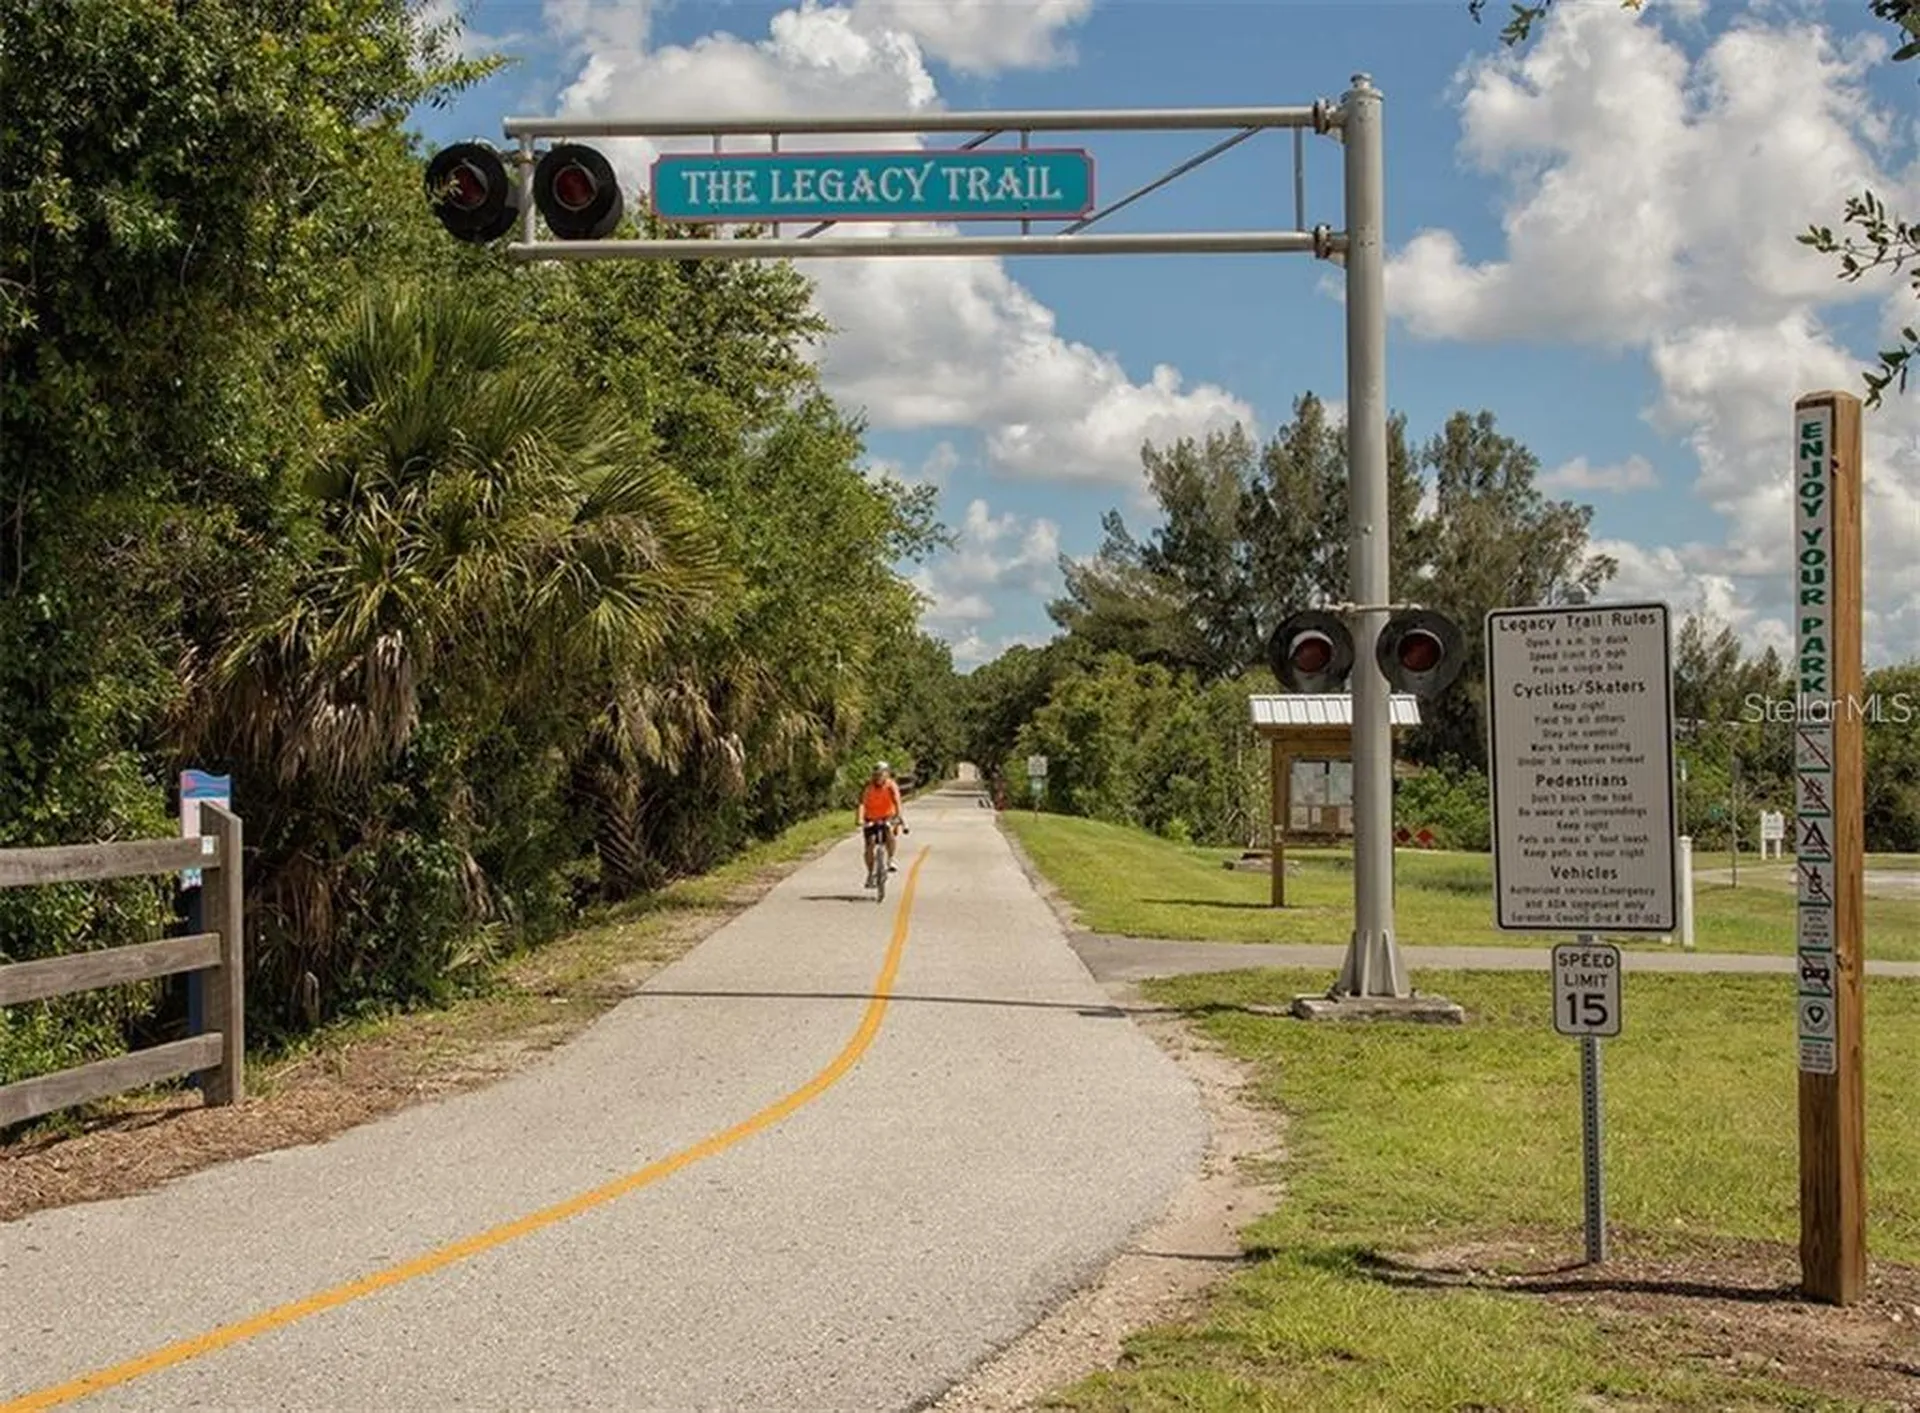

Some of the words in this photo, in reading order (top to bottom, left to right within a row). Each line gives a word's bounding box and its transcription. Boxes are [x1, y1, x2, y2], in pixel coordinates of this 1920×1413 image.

[681, 169, 758, 205] THE
[769, 161, 936, 203] LEGACY
[941, 166, 1062, 202] TRAIL
[1800, 421, 1826, 517] ENJOY
[1800, 528, 1826, 606] YOUR
[1499, 618, 1556, 633] Legacy
[1566, 615, 1602, 628] Trail
[1611, 612, 1656, 626] Rules
[1529, 652, 1557, 661] Speed
[1590, 649, 1600, 658] 15
[1606, 648, 1626, 658] mph
[1800, 617, 1826, 693] PARK
[1573, 664, 1602, 674] single
[1513, 680, 1646, 698] Cyclists/Skaters
[1553, 702, 1576, 711] Keep
[1581, 701, 1605, 712] right
[1534, 716, 1558, 724] Yield
[1563, 716, 1572, 724] to
[1578, 715, 1589, 723] all
[1582, 728, 1618, 736] control
[1558, 743, 1589, 752] before
[1594, 743, 1631, 752] passing
[1610, 755, 1644, 763] helmet
[1536, 774, 1627, 787] Pedestrians
[1561, 793, 1586, 802] block
[1591, 793, 1608, 802] the
[1519, 807, 1530, 816] Be
[1557, 821, 1580, 830] Keep
[1584, 821, 1608, 831] right
[1524, 849, 1546, 858] Keep
[1576, 849, 1588, 857] on
[1593, 849, 1614, 858] your
[1619, 848, 1644, 859] right
[1550, 866, 1618, 879] Vehicles
[1557, 913, 1588, 922] County
[1559, 953, 1614, 968] SPEED
[1565, 973, 1607, 987] LIMIT
[1567, 992, 1608, 1026] 15
